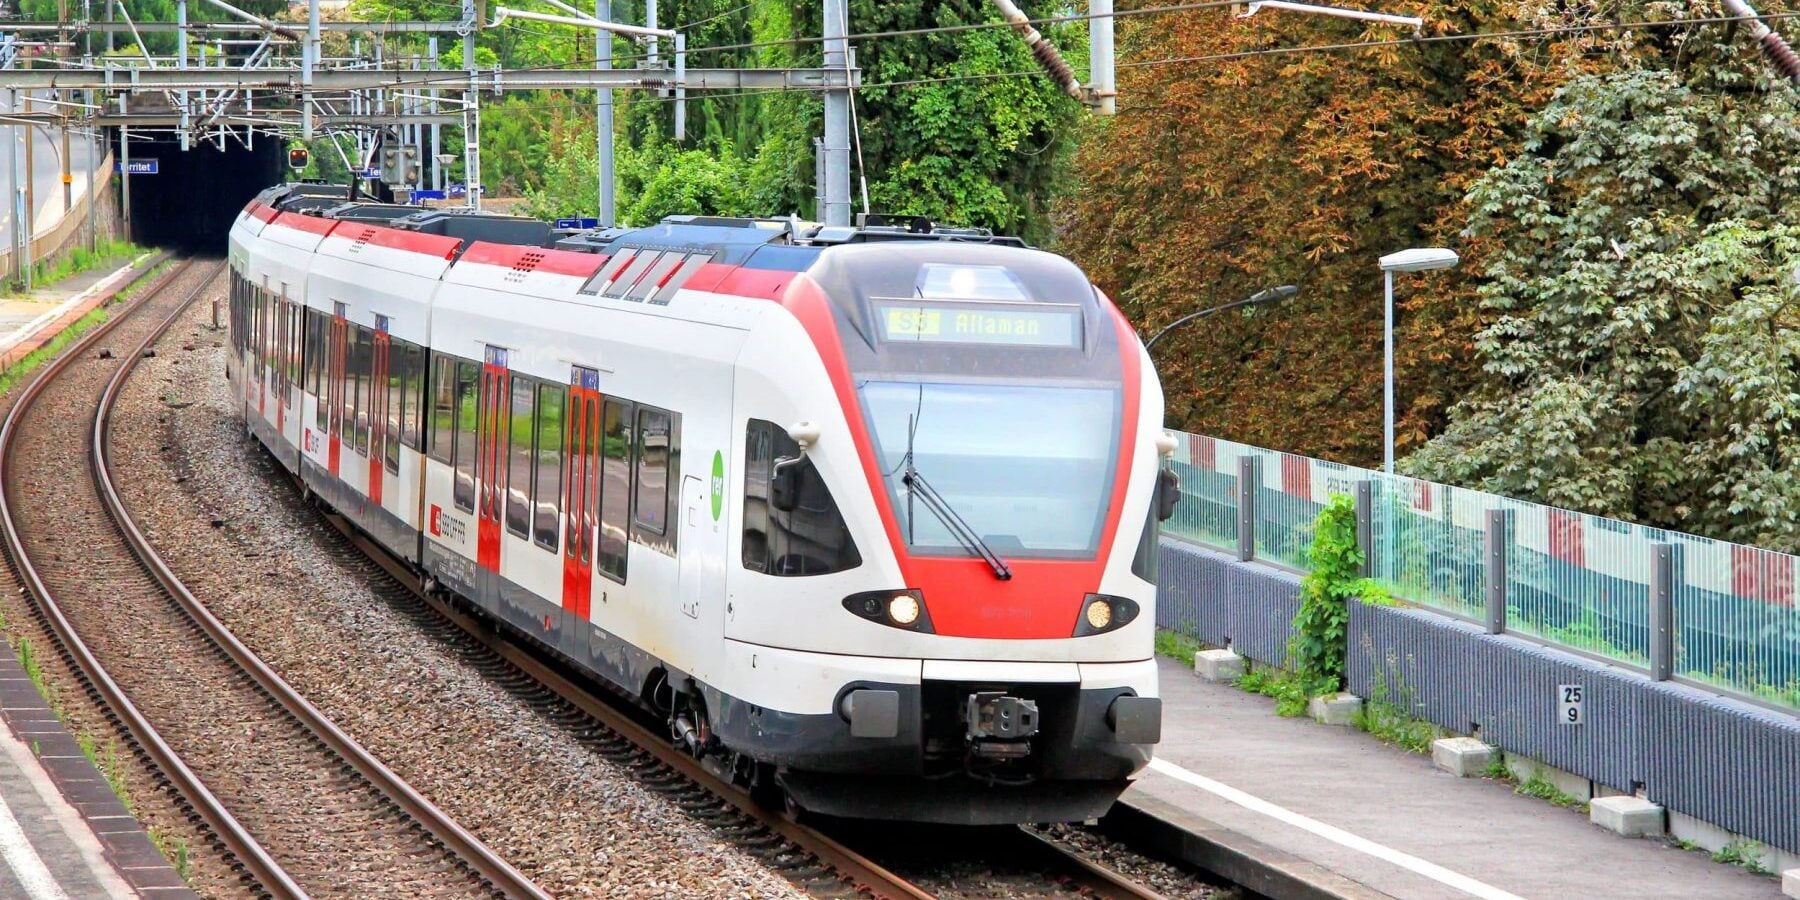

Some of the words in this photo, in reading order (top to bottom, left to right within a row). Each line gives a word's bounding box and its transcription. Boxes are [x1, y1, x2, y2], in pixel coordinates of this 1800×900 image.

[955, 313, 1039, 336] Allaman
[441, 512, 450, 537] SBB
[1564, 687, 1582, 703] 25
[1568, 707, 1578, 722] 9
